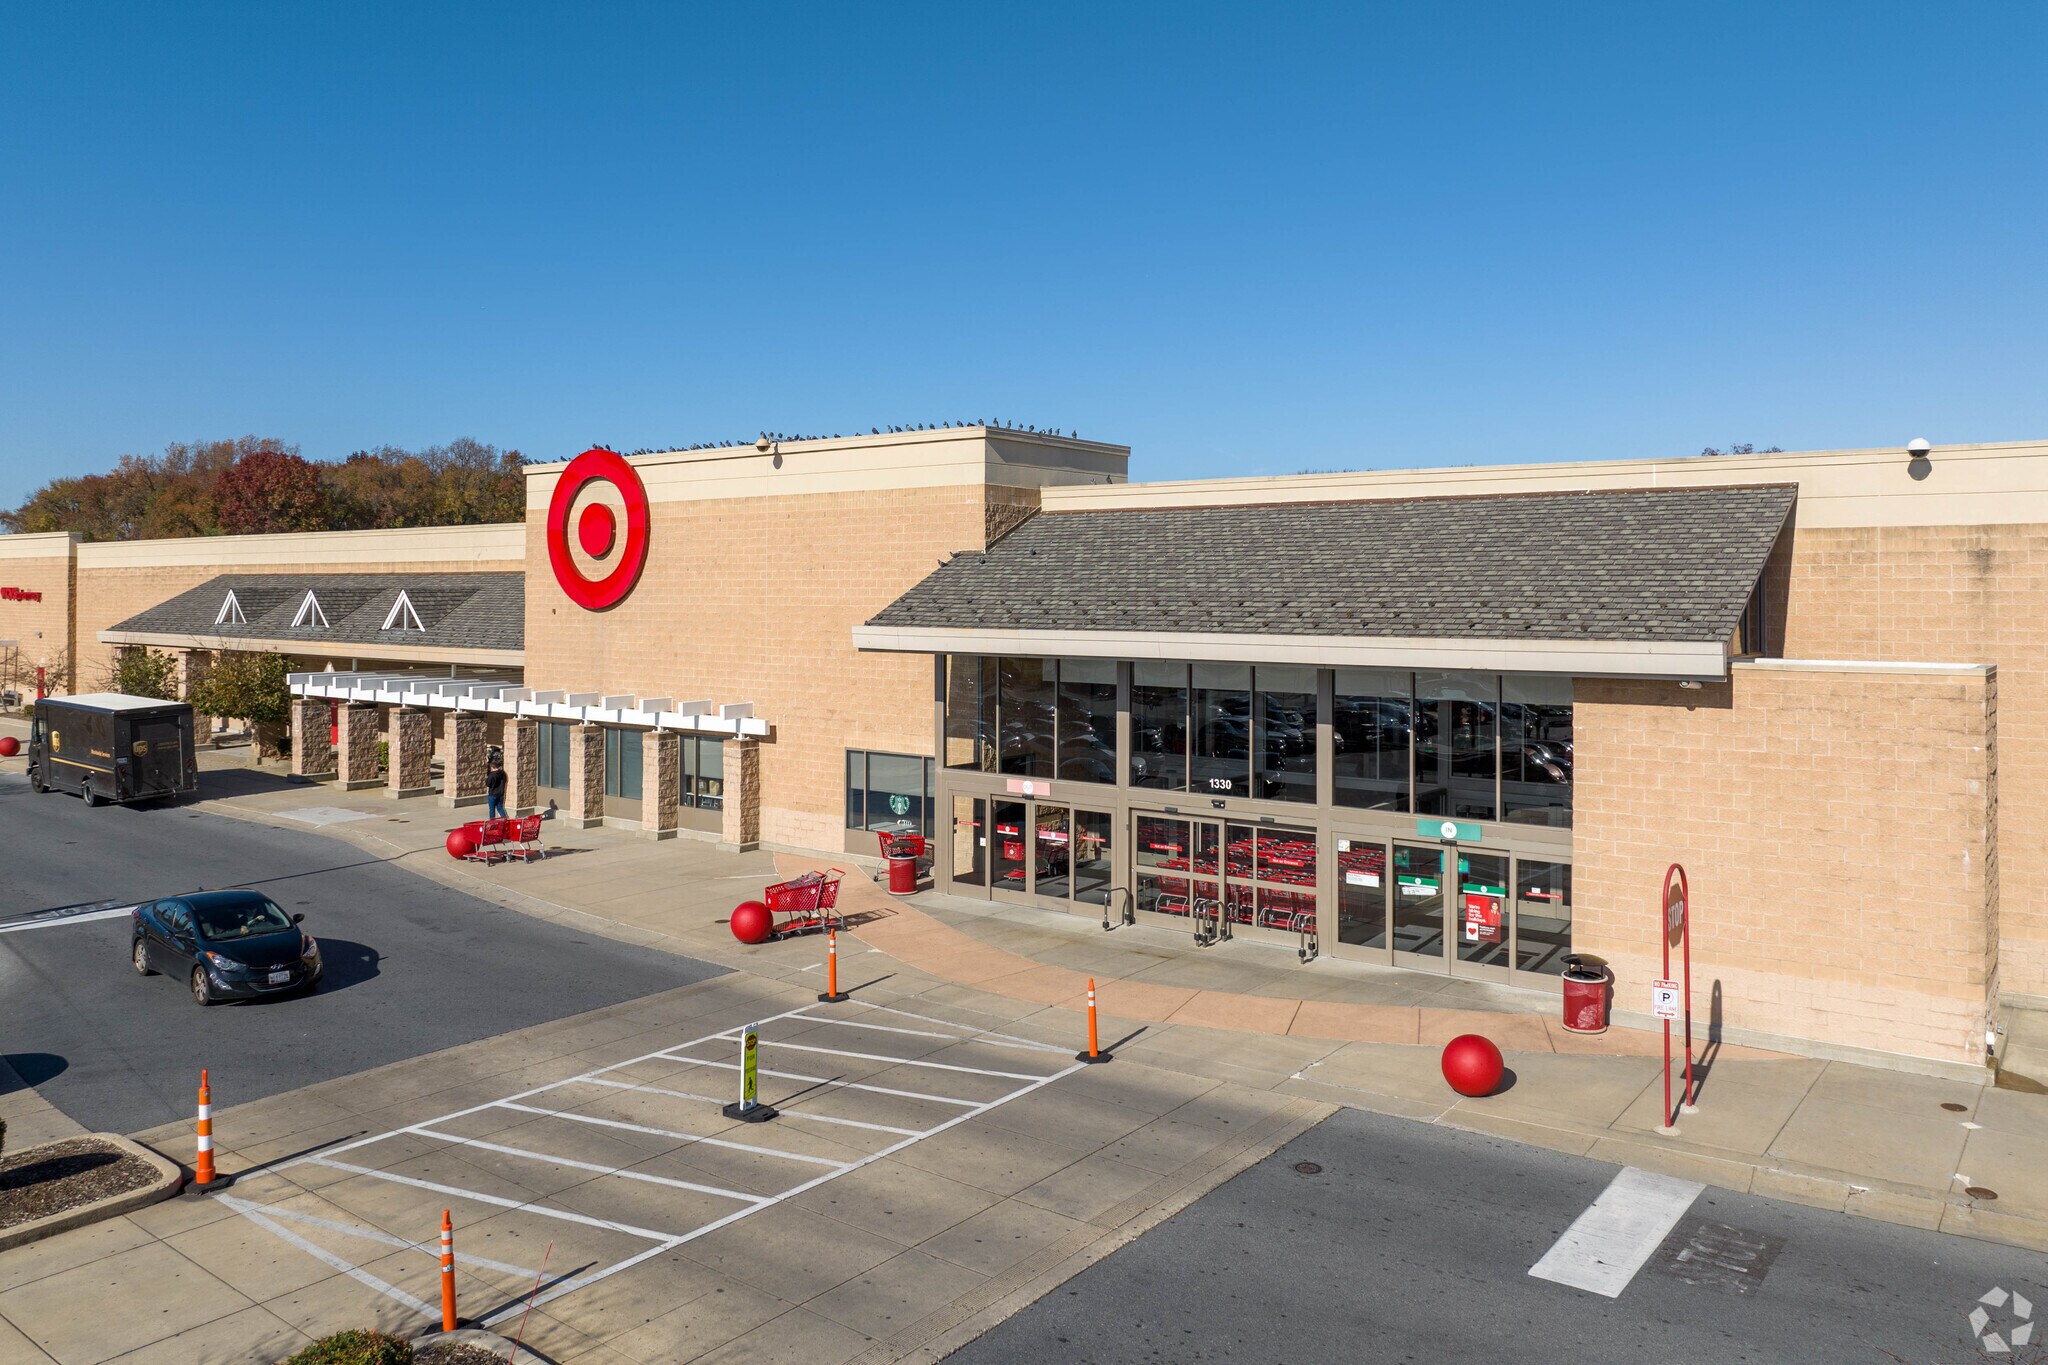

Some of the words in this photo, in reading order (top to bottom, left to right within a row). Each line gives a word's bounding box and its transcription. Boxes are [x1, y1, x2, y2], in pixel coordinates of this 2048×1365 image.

[1209, 778, 1232, 790] 1330
[1668, 900, 1684, 931] STOP
[1661, 981, 1678, 989] PARKING
